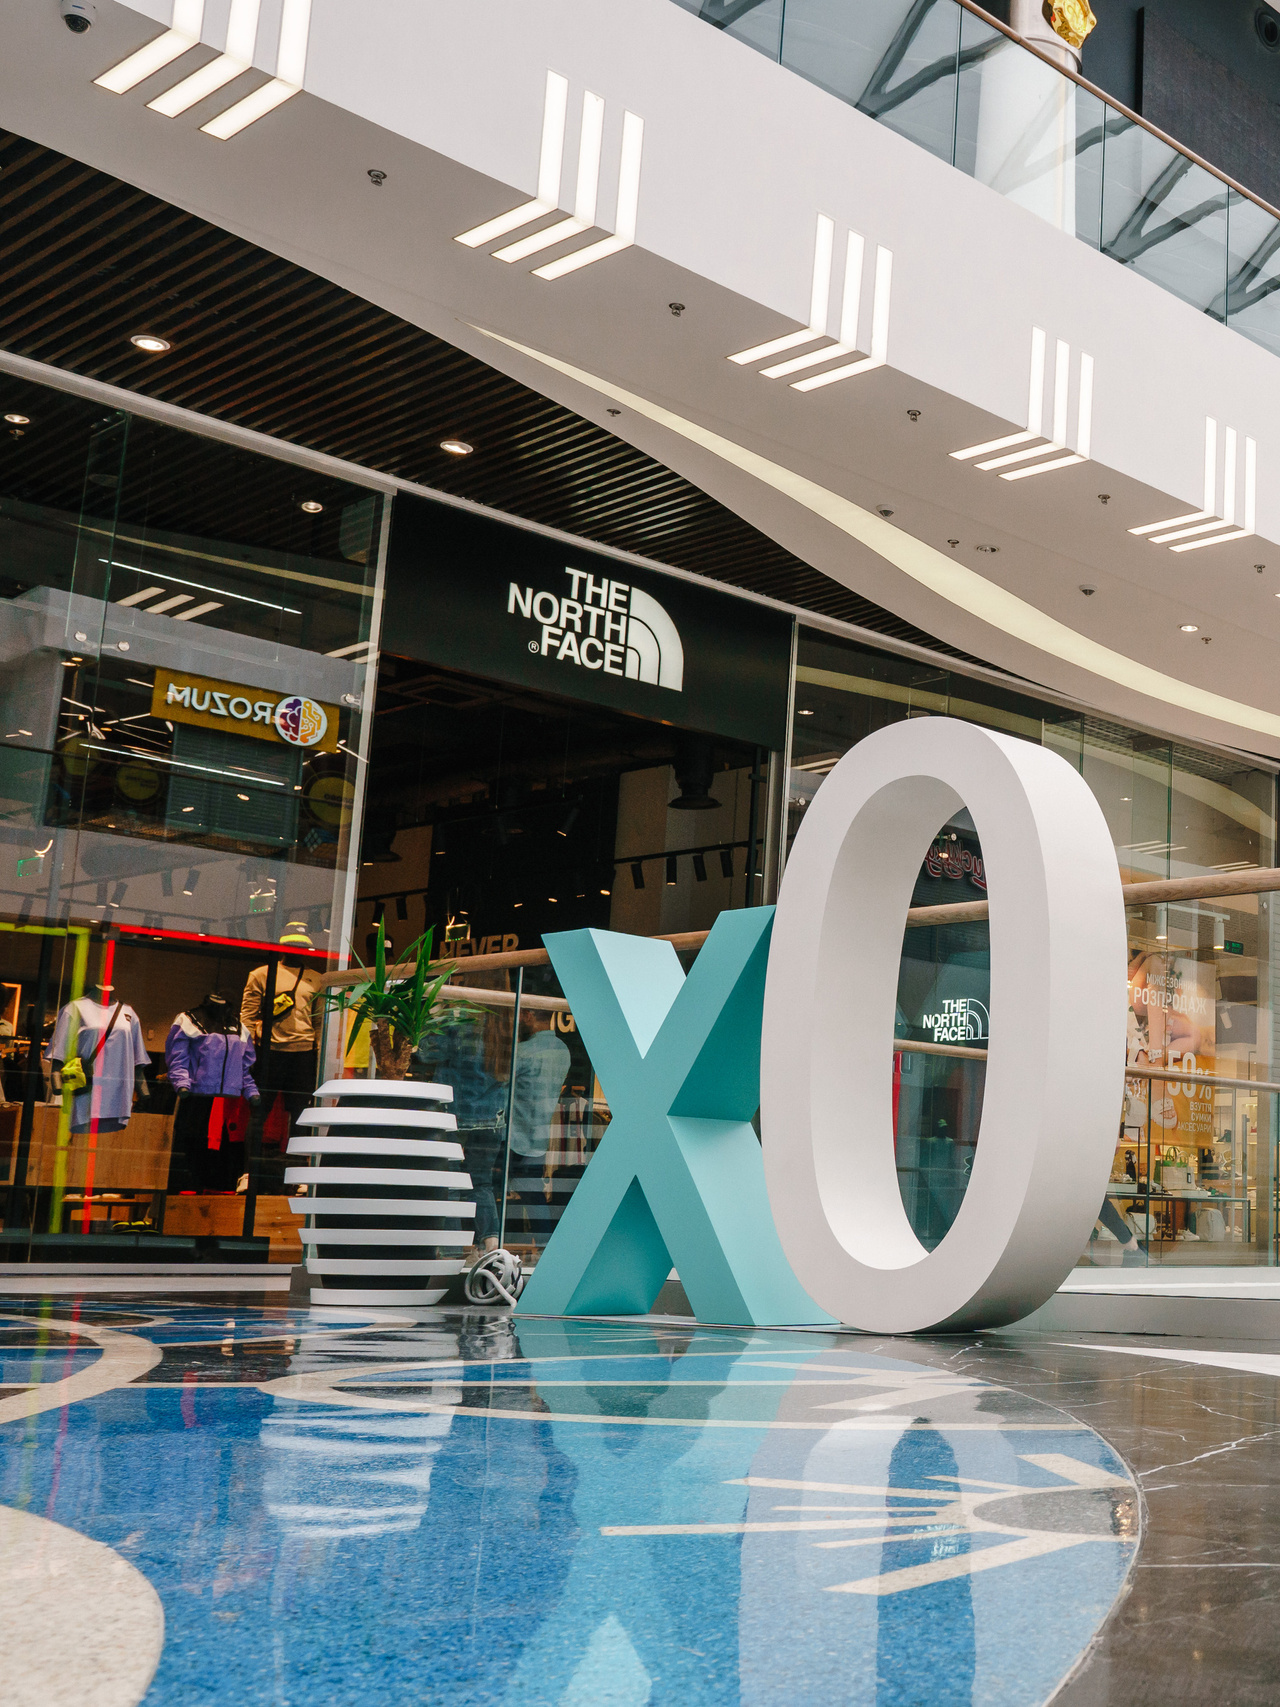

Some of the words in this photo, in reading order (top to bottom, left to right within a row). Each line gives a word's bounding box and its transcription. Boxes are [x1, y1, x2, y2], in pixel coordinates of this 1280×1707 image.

[565, 566, 630, 614] THE
[507, 582, 627, 645] NORTH
[540, 624, 625, 676] FACE
[942, 999, 968, 1014] THE
[1134, 986, 1207, 1015] РОЗПРОДАЖ
[922, 1012, 967, 1029] NORTH
[933, 1026, 967, 1042] FACE
[1189, 1101, 1212, 1113] ВЗУТТЯ
[1190, 1112, 1212, 1123] СУМКИ
[1177, 1121, 1212, 1134] АКСЕСУАРИ
